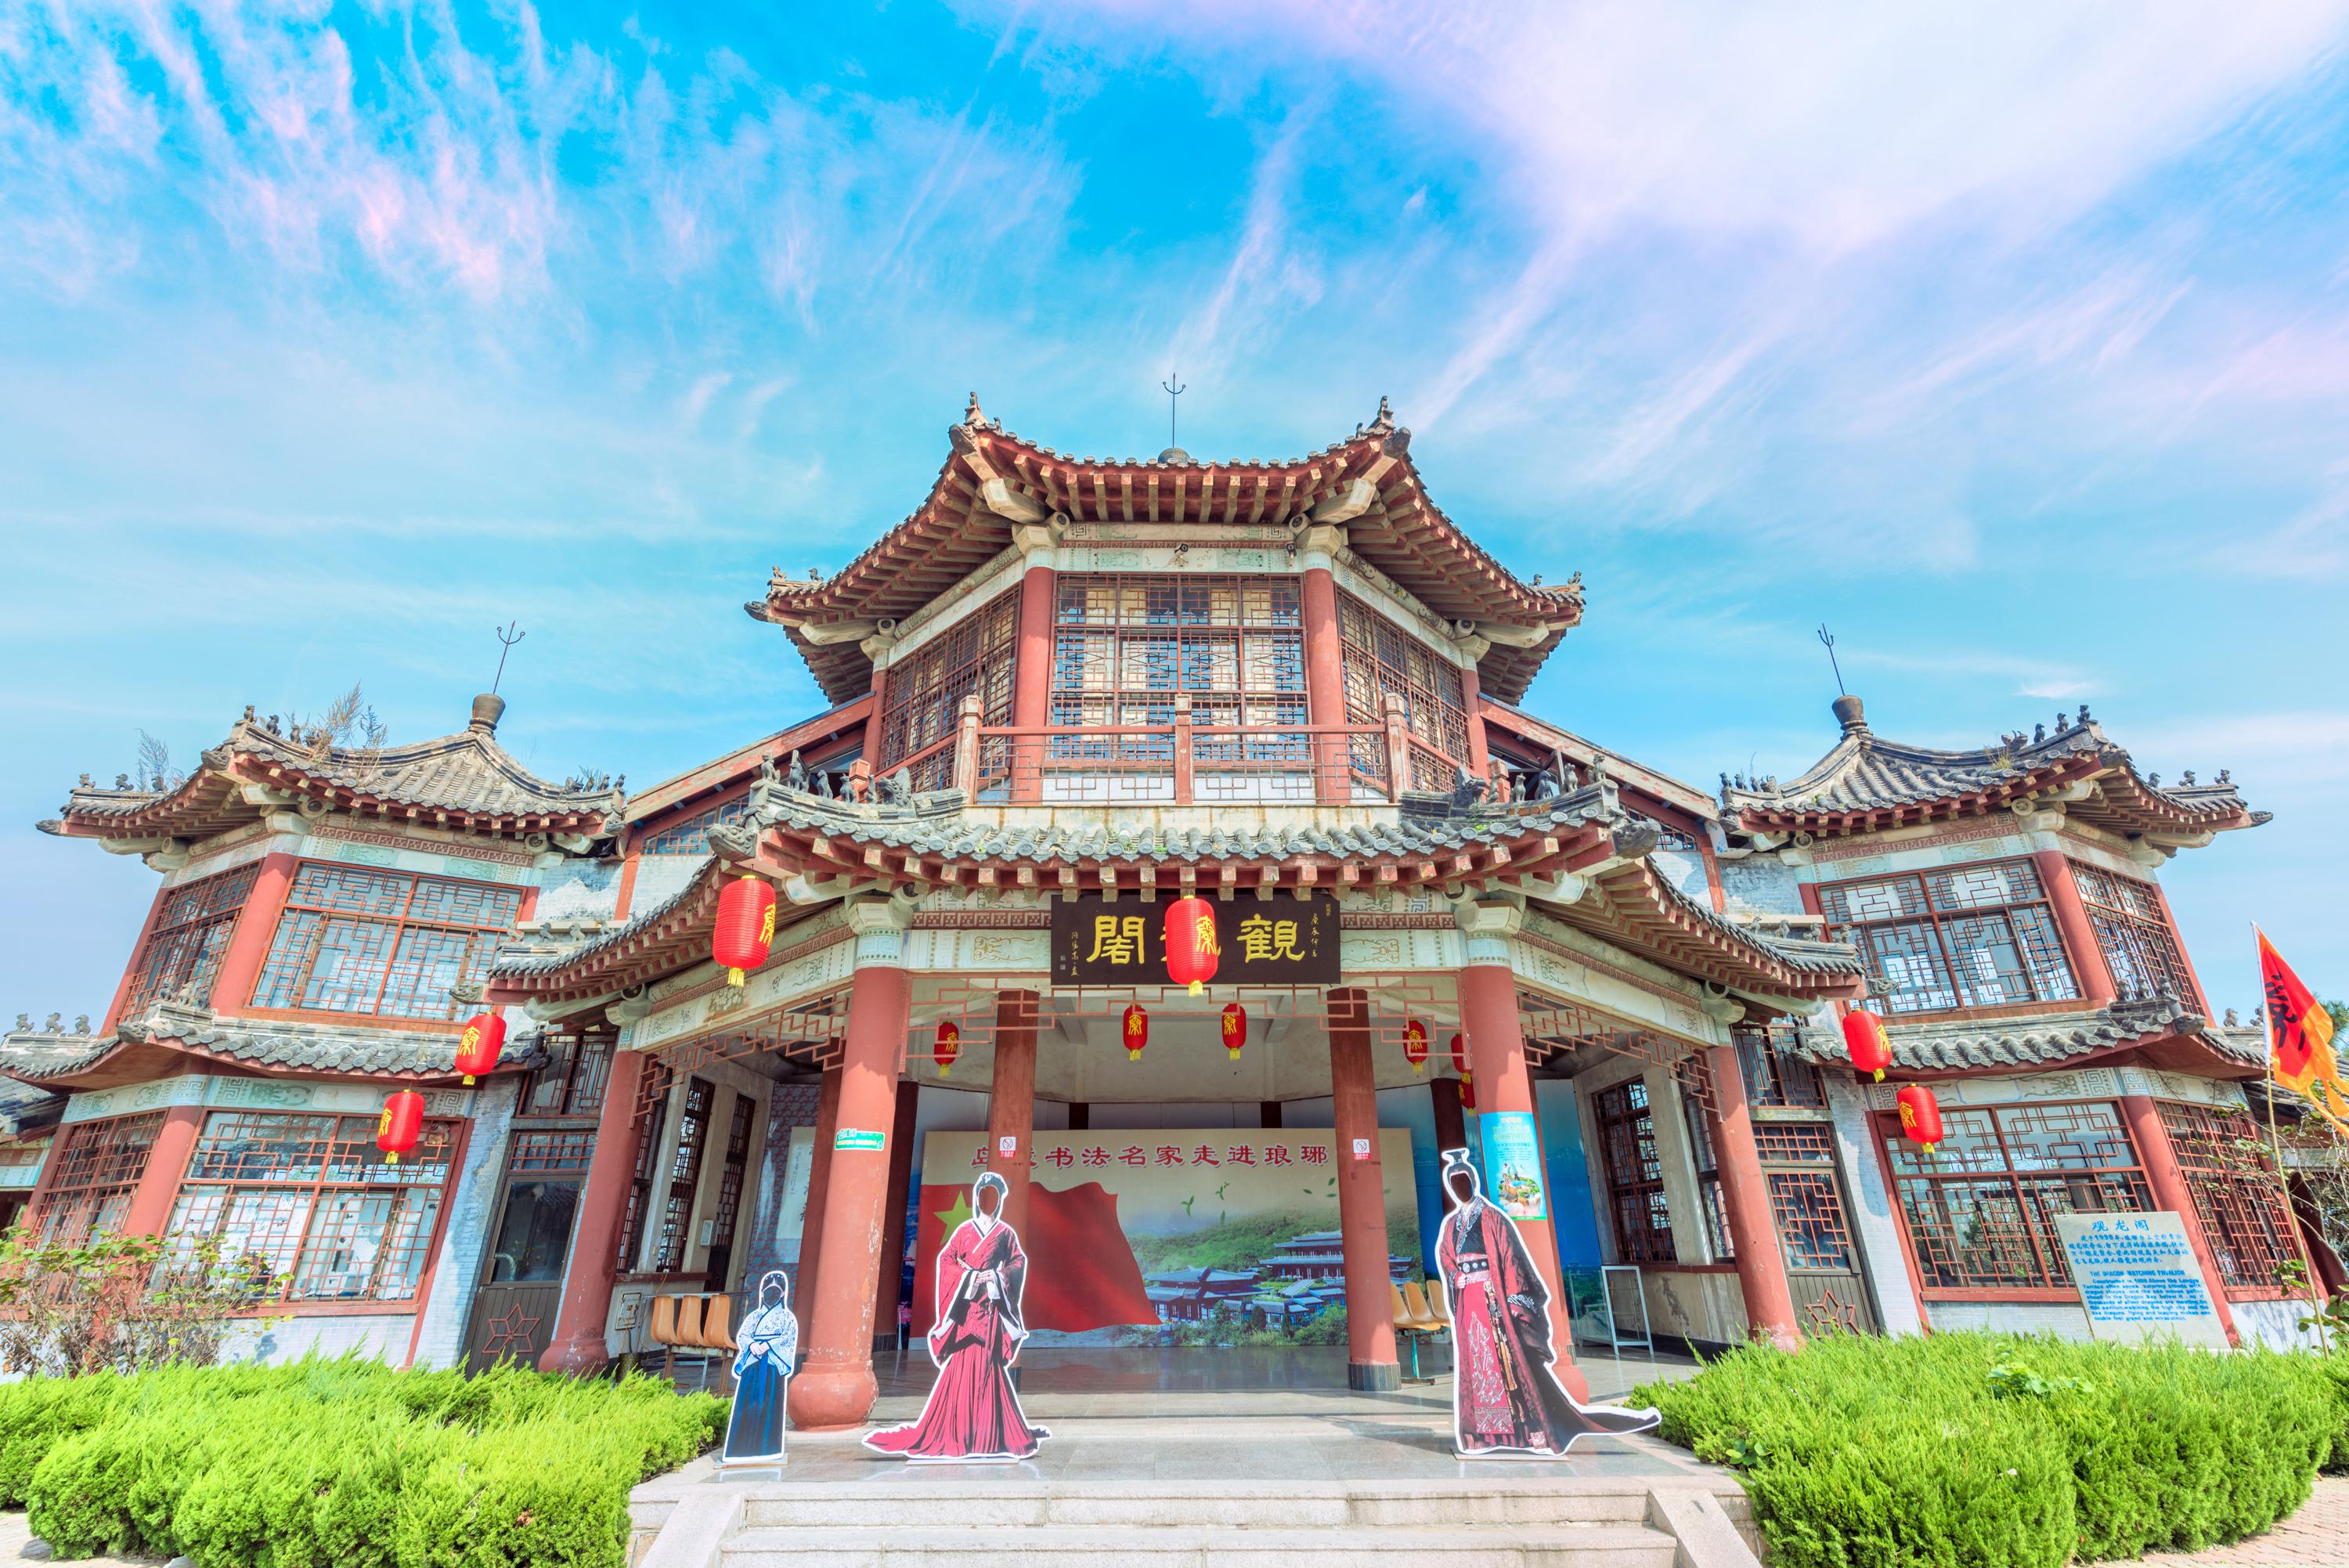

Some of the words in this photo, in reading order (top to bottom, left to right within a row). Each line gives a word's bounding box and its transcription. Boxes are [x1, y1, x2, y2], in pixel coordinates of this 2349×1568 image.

[972, 1144, 1329, 1167] 岛书法名家走进琅琊
[2092, 1219, 2150, 1233] 观龙阁
